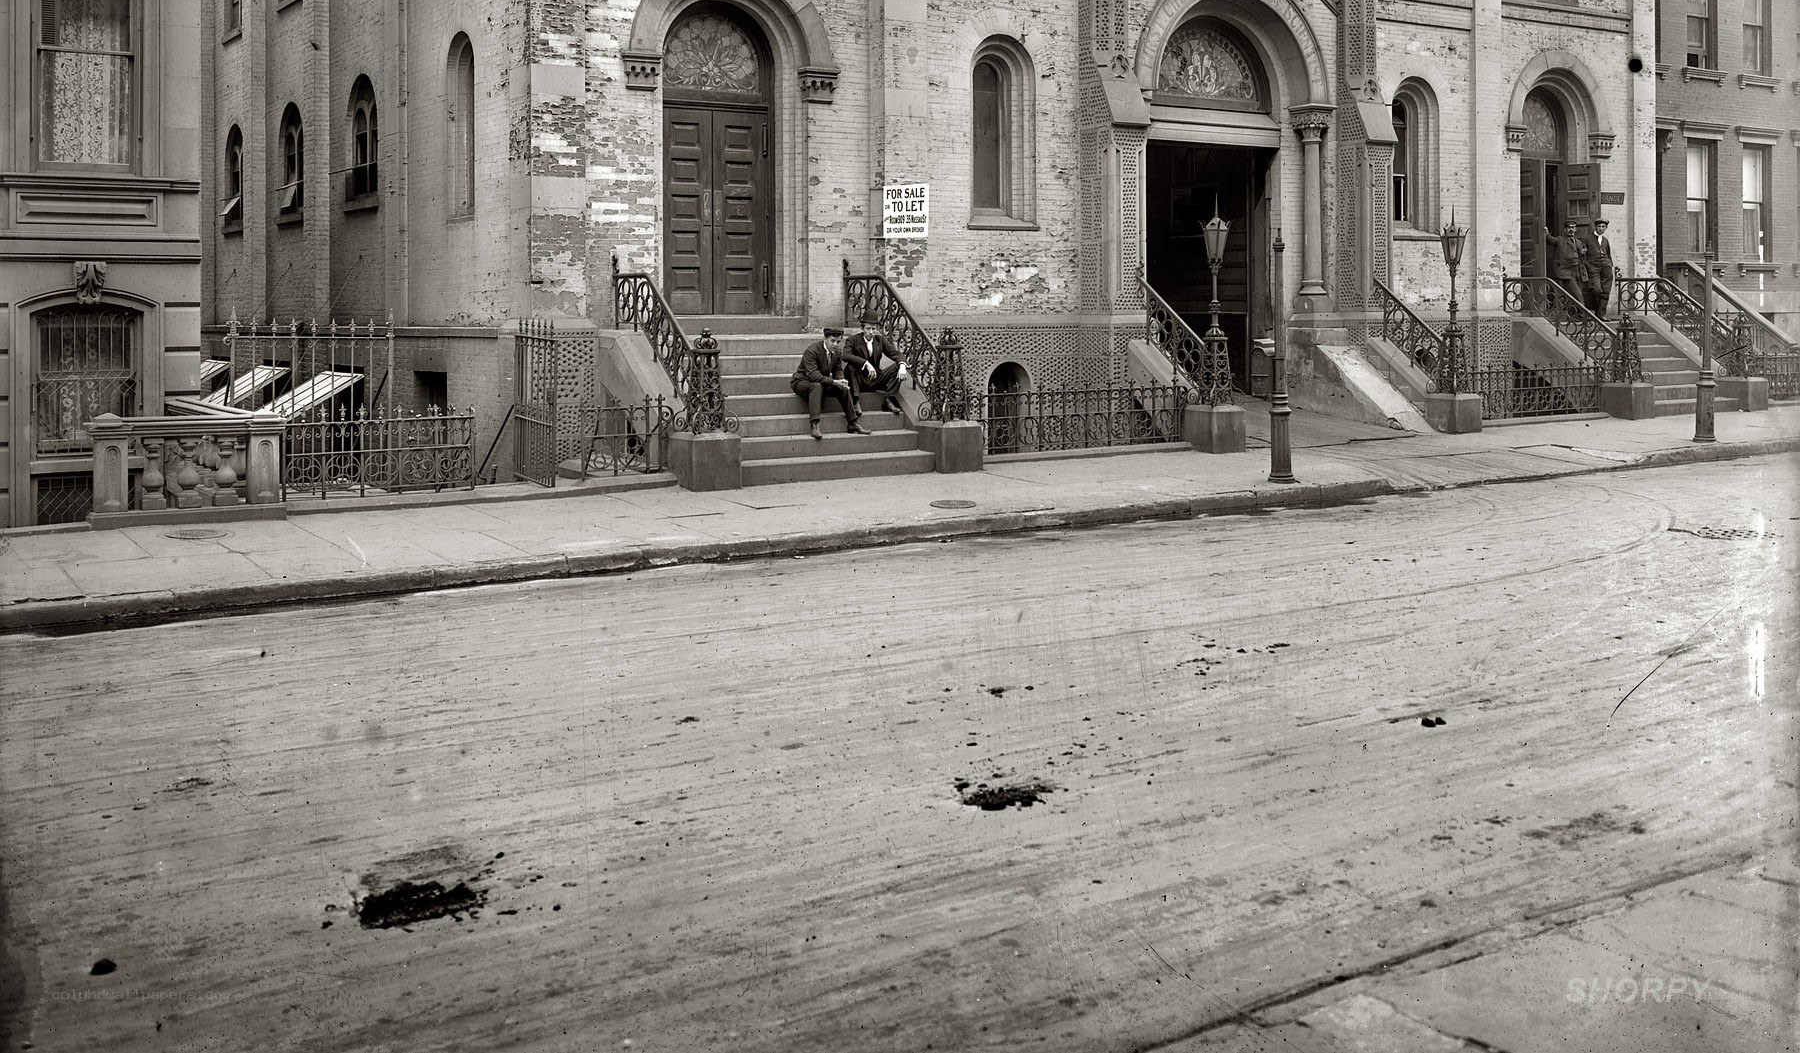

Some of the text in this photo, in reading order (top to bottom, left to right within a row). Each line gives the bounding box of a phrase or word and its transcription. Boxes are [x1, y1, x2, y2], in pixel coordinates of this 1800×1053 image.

[887, 188, 925, 199] FOR SALE
[892, 201, 903, 212] TO
[905, 200, 924, 212] LET
